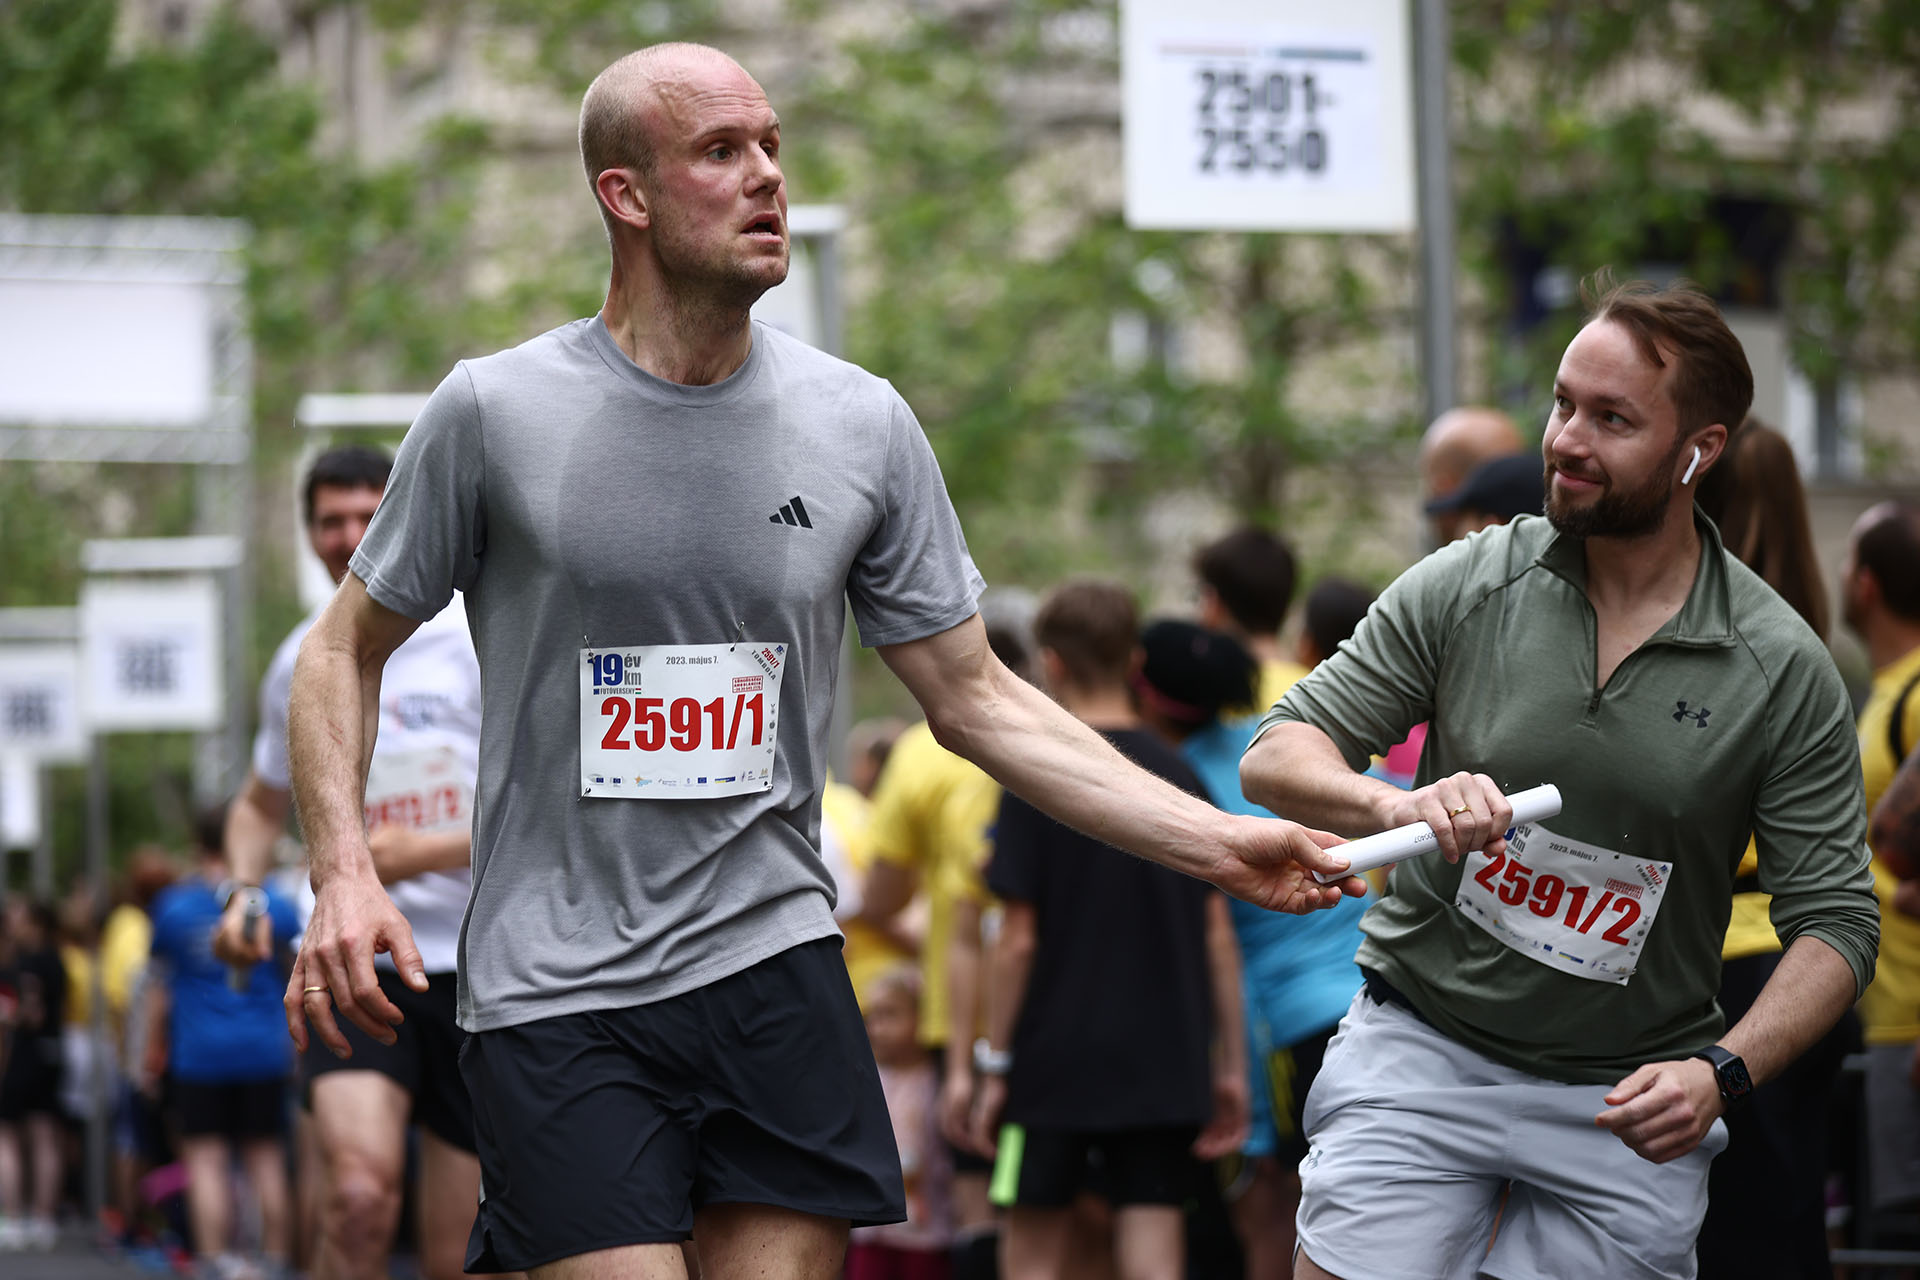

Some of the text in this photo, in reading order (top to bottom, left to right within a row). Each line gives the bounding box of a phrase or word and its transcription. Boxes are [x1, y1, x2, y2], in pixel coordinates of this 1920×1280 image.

[1198, 126, 1327, 174] 2550
[587, 654, 623, 686] 19
[624, 653, 641, 668] év
[666, 655, 719, 665] 2023. május 7.
[751, 650, 776, 680] TOMBOLA
[761, 647, 780, 669] 2591/1
[624, 670, 641, 685] km
[601, 693, 763, 752] 2591/1
[1511, 833, 1526, 853] km
[1474, 850, 1641, 946] 2591/2
